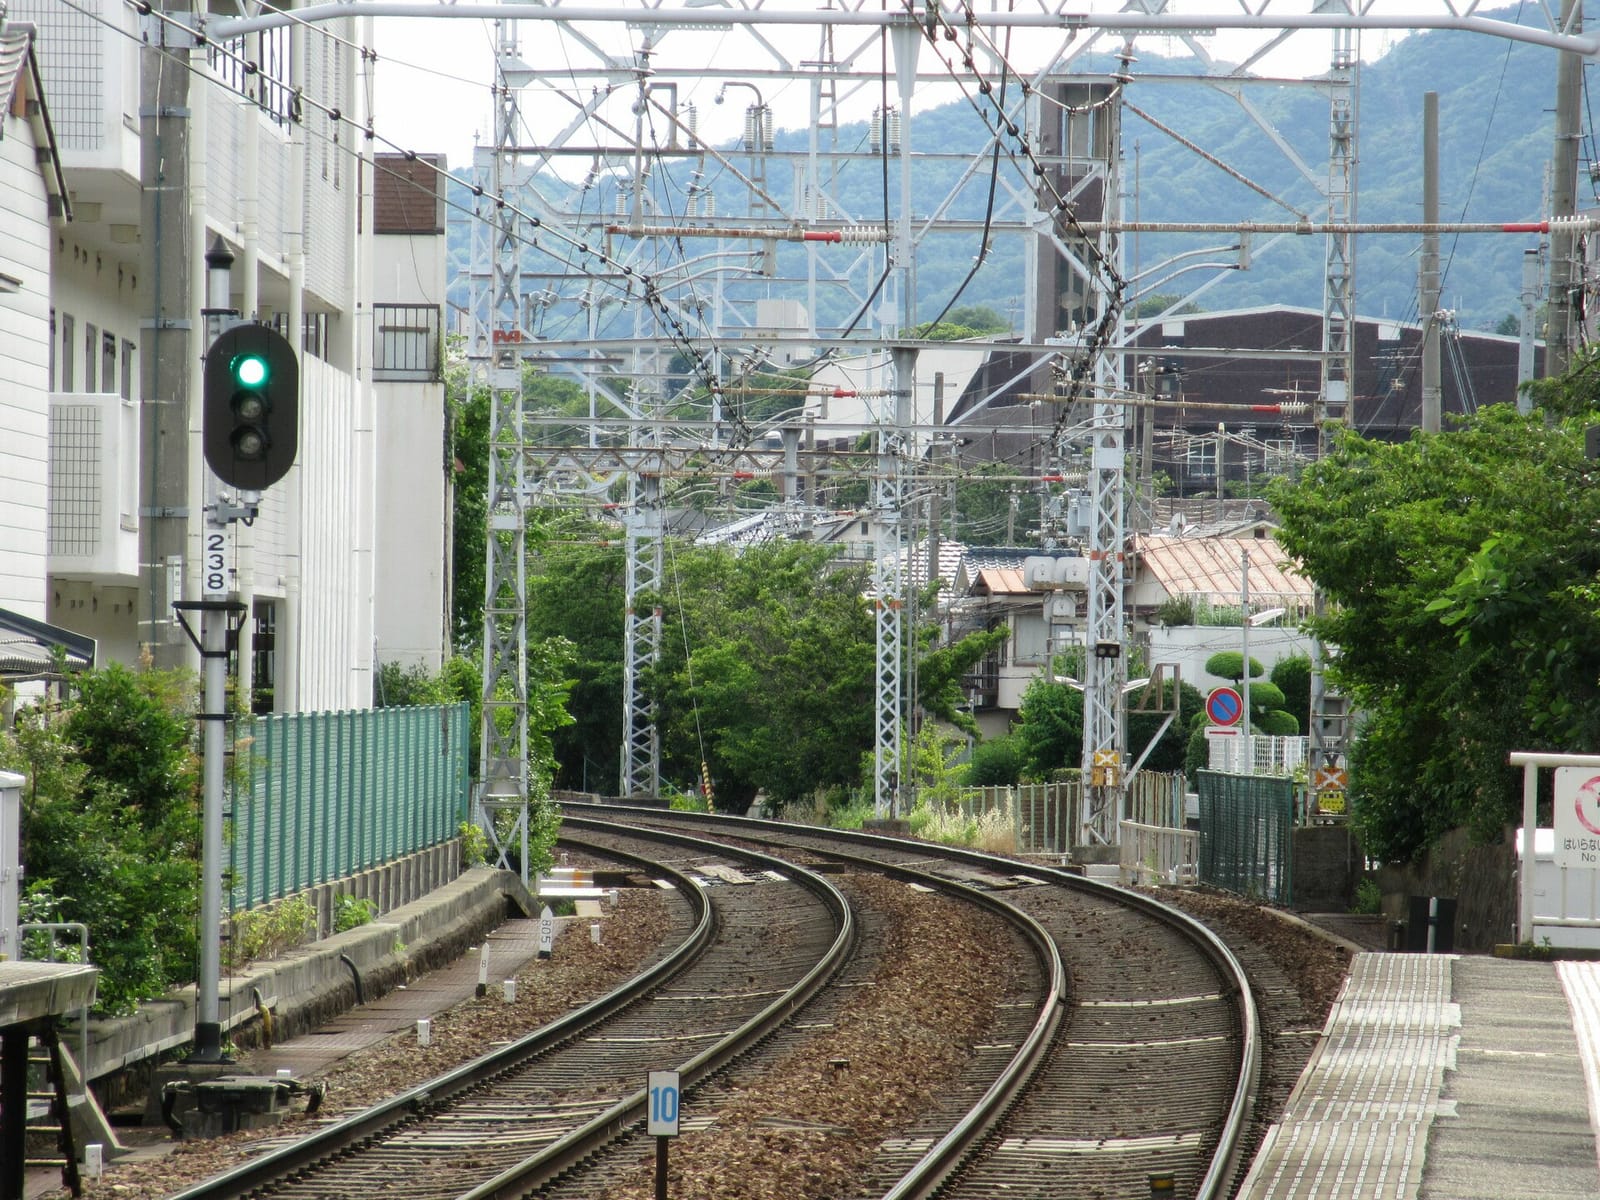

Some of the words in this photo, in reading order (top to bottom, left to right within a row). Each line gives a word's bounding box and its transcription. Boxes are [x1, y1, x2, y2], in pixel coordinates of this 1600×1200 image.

[207, 534, 225, 590] 238
[1581, 852, 1597, 862] No
[541, 920, 552, 944] 805
[650, 1086, 678, 1122] 10
